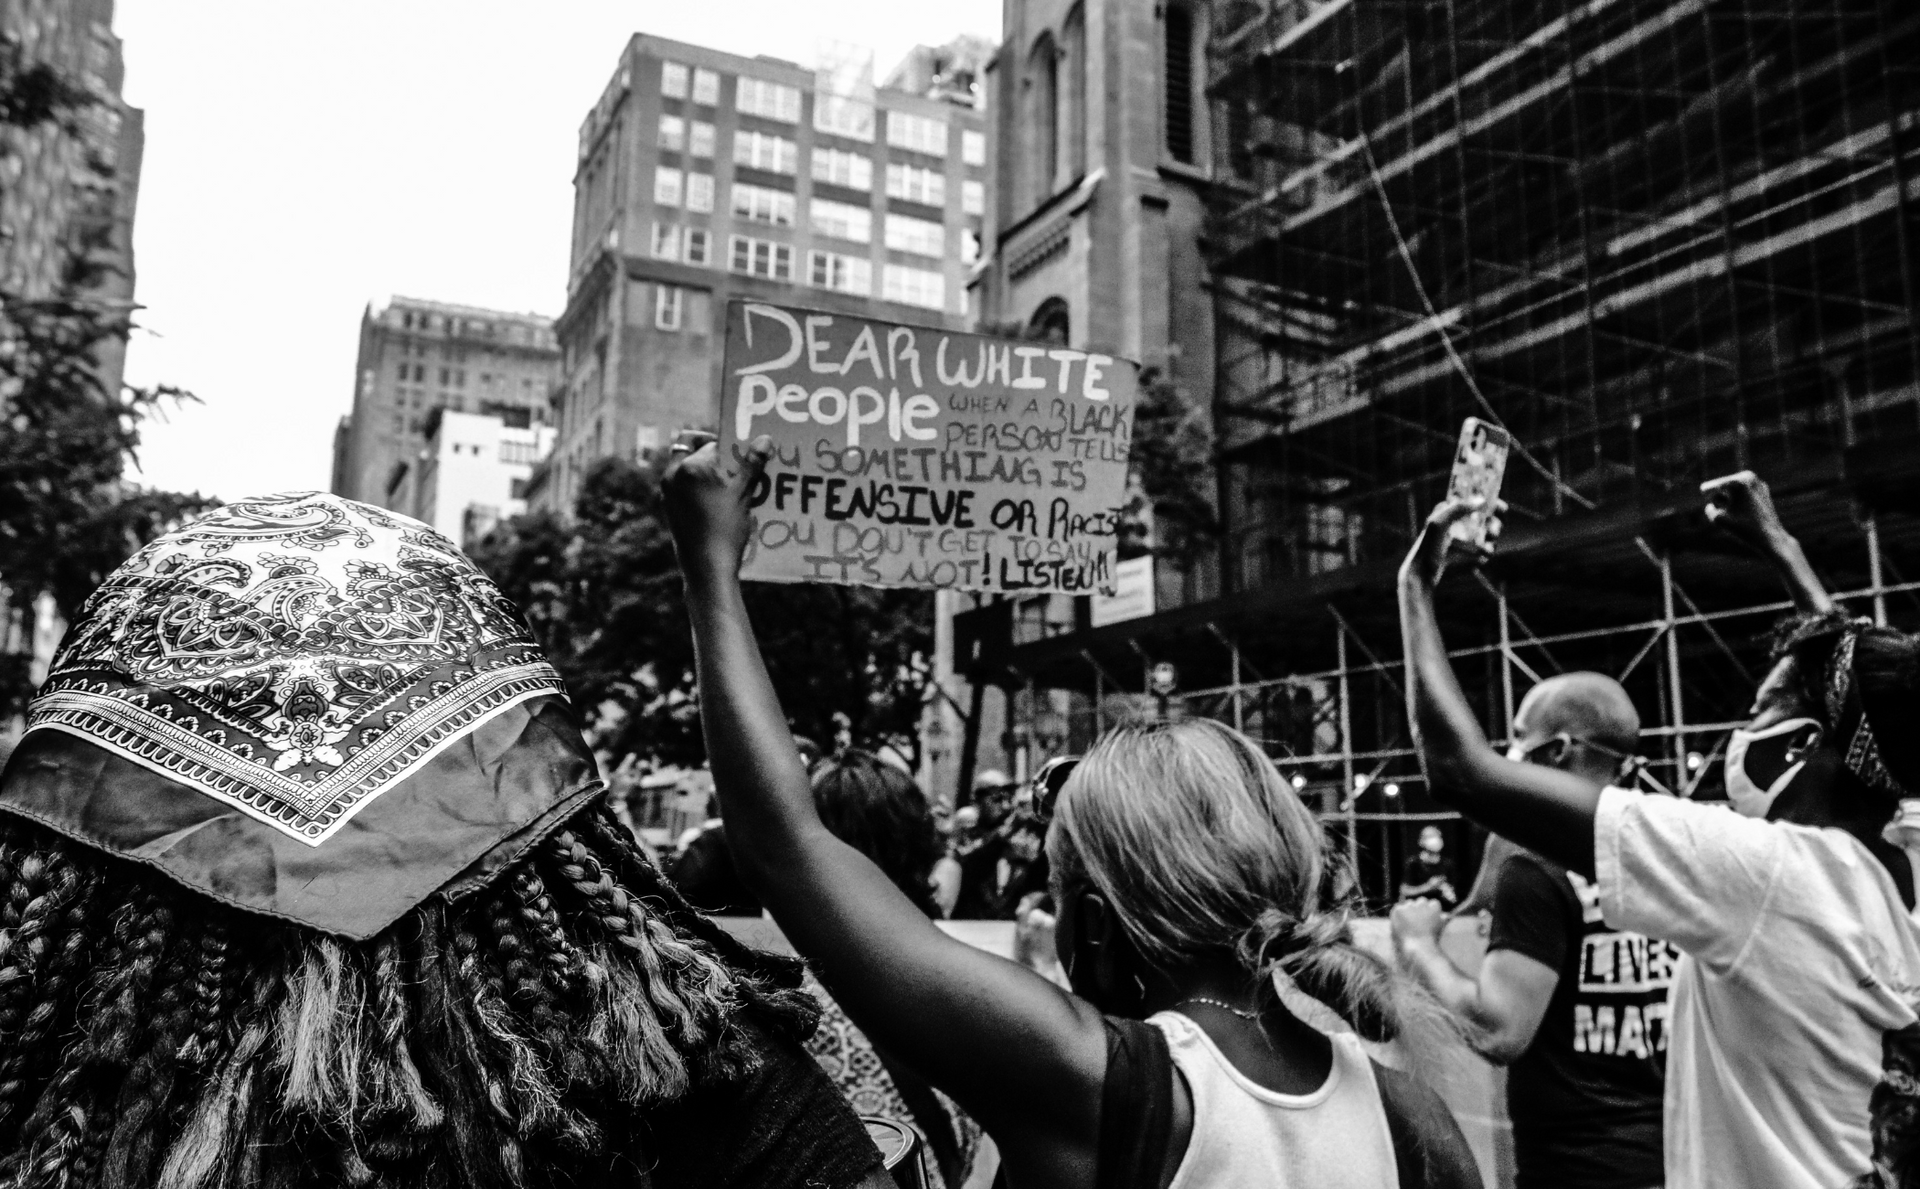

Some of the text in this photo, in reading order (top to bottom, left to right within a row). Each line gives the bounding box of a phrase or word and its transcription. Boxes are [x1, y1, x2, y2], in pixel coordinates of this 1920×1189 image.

[734, 303, 1113, 400] DEAR WHITE
[949, 393, 1010, 413] WHEN
[1022, 398, 1040, 417] A
[1049, 398, 1130, 441] BLACK
[815, 438, 1042, 488] SOMETHING
[1050, 459, 1087, 492] IS
[945, 421, 1130, 464] PERSON TELLS
[744, 472, 976, 529] OFFENSIVE
[990, 498, 1038, 537] OR
[801, 552, 882, 583] IT'S
[938, 529, 996, 558] GET
[1007, 535, 1042, 562] TO
[1046, 538, 1091, 571] SAY
